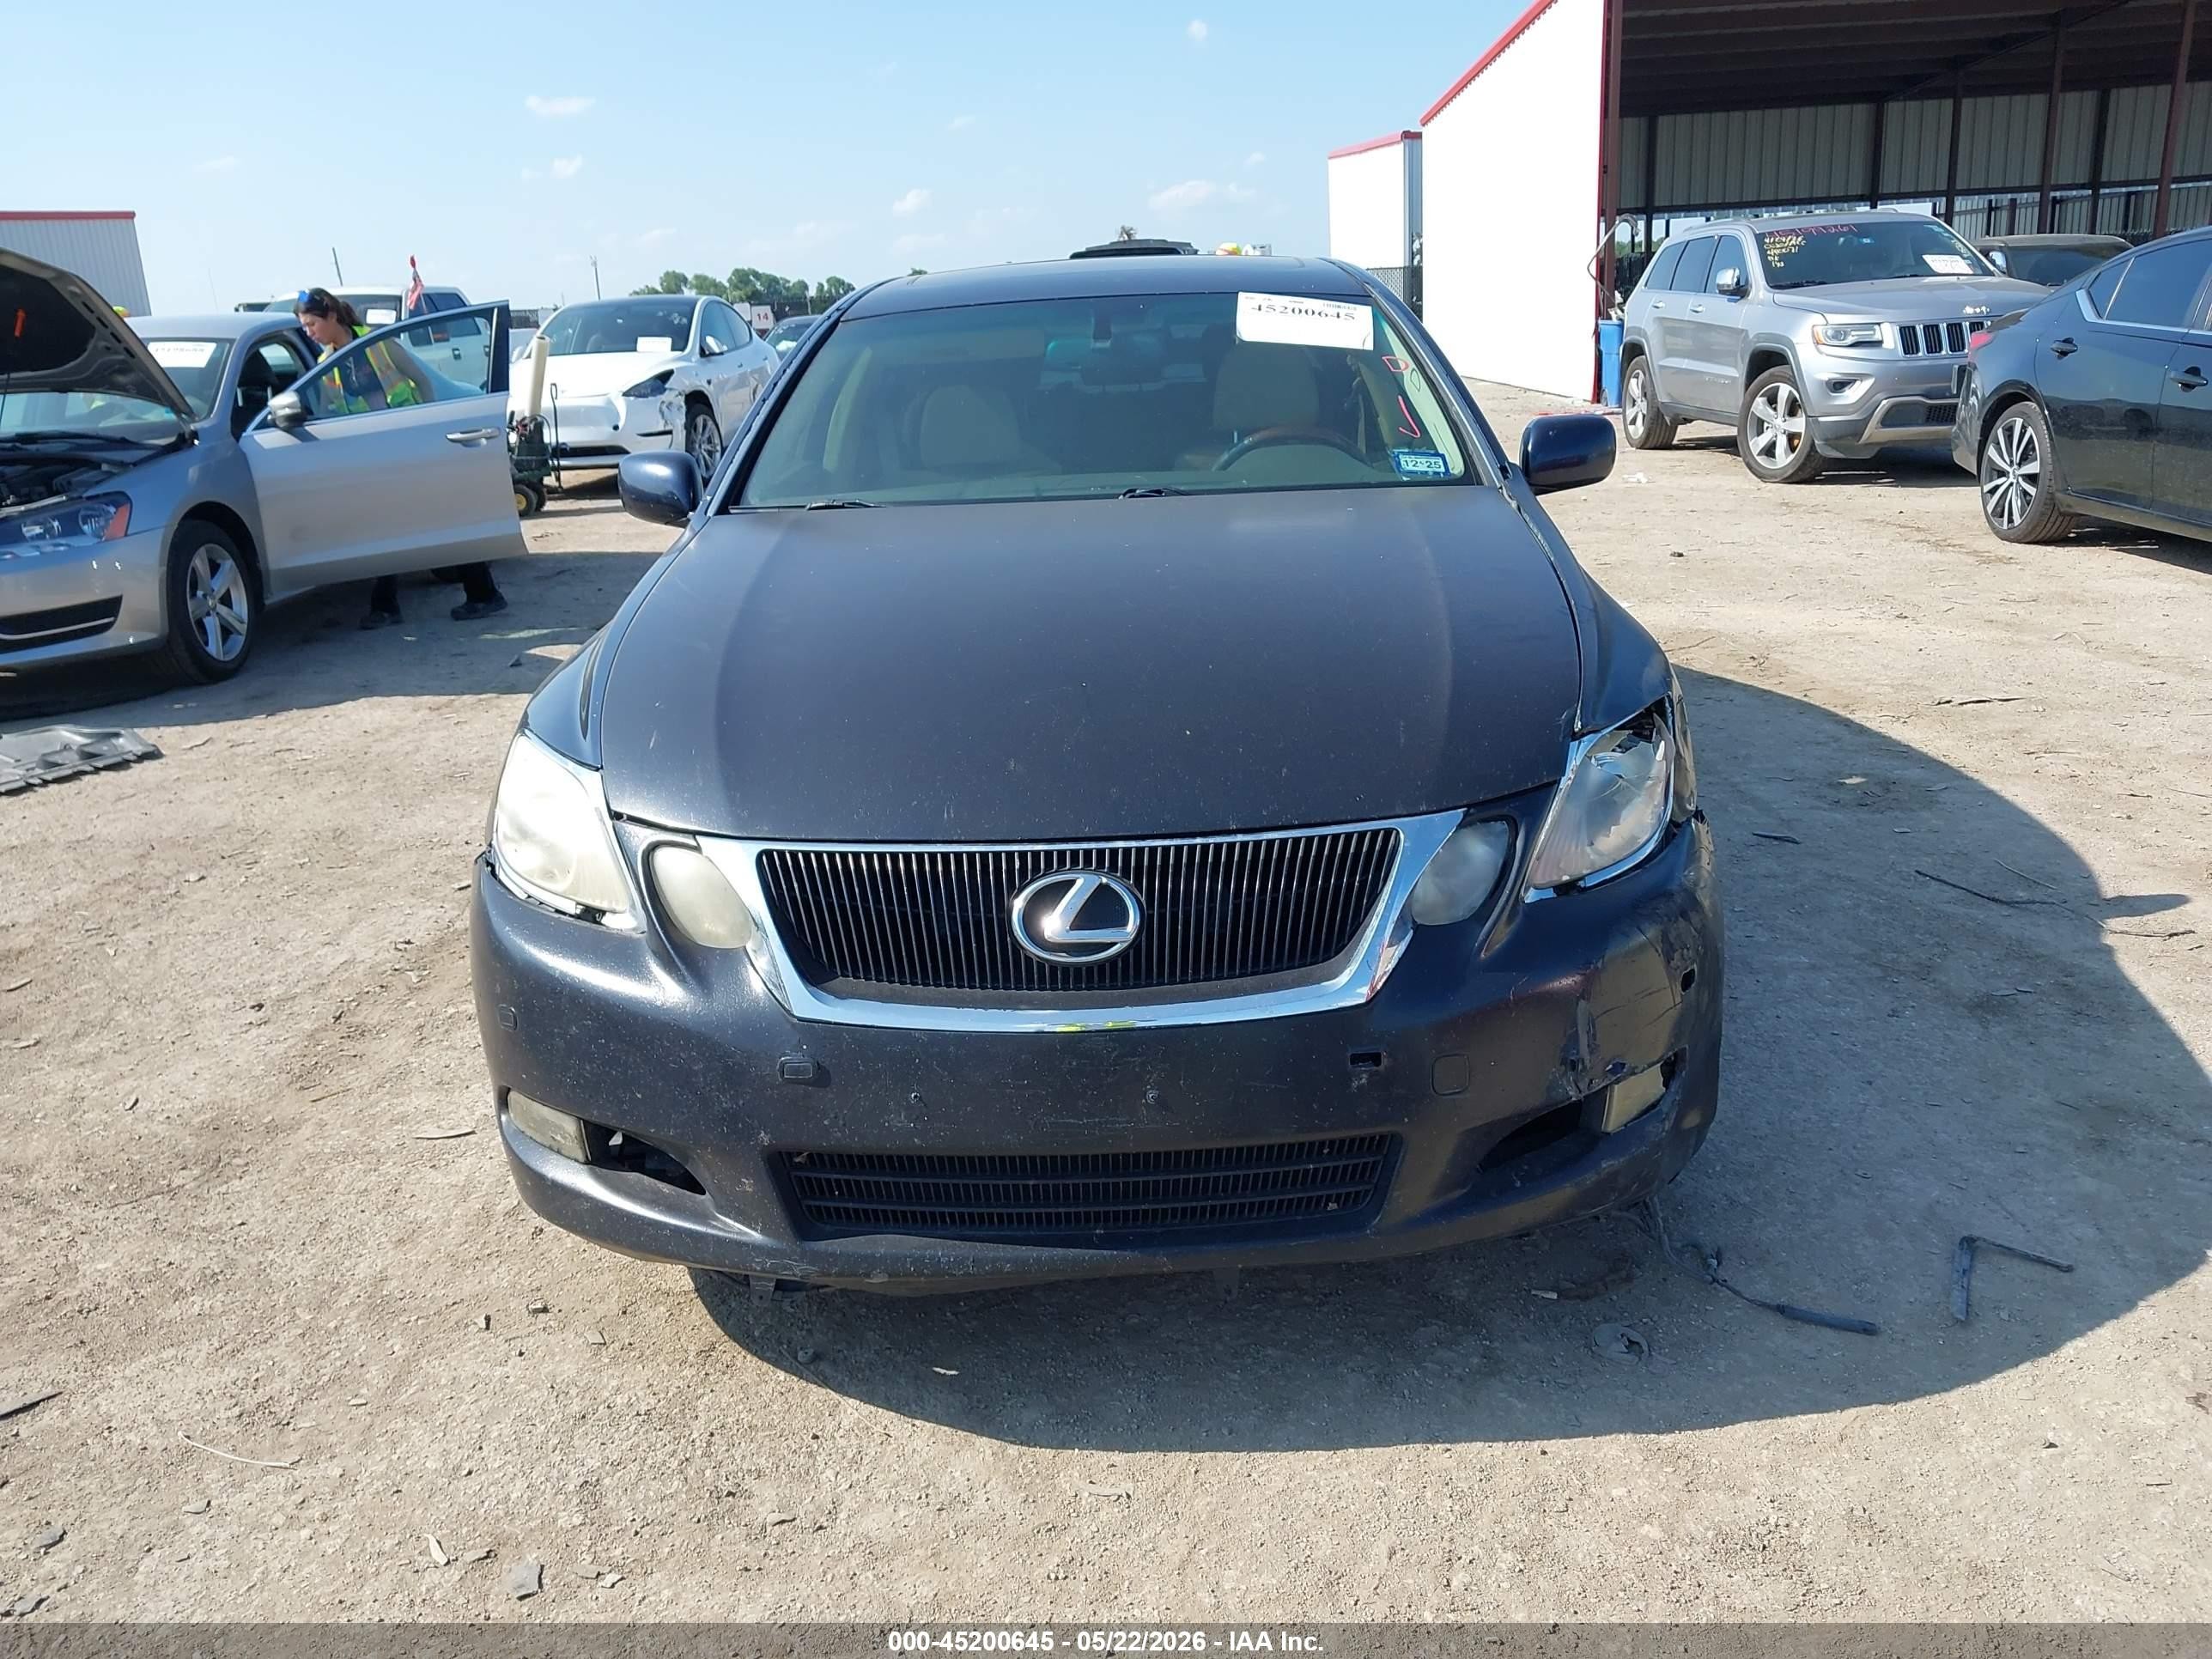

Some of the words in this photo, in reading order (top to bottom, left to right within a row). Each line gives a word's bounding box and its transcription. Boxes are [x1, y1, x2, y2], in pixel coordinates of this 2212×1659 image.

[757, 313, 769, 321] 14
[1251, 303, 1356, 321] 45200645
[1403, 459, 1419, 468] 12
[1425, 460, 1442, 470] 25
